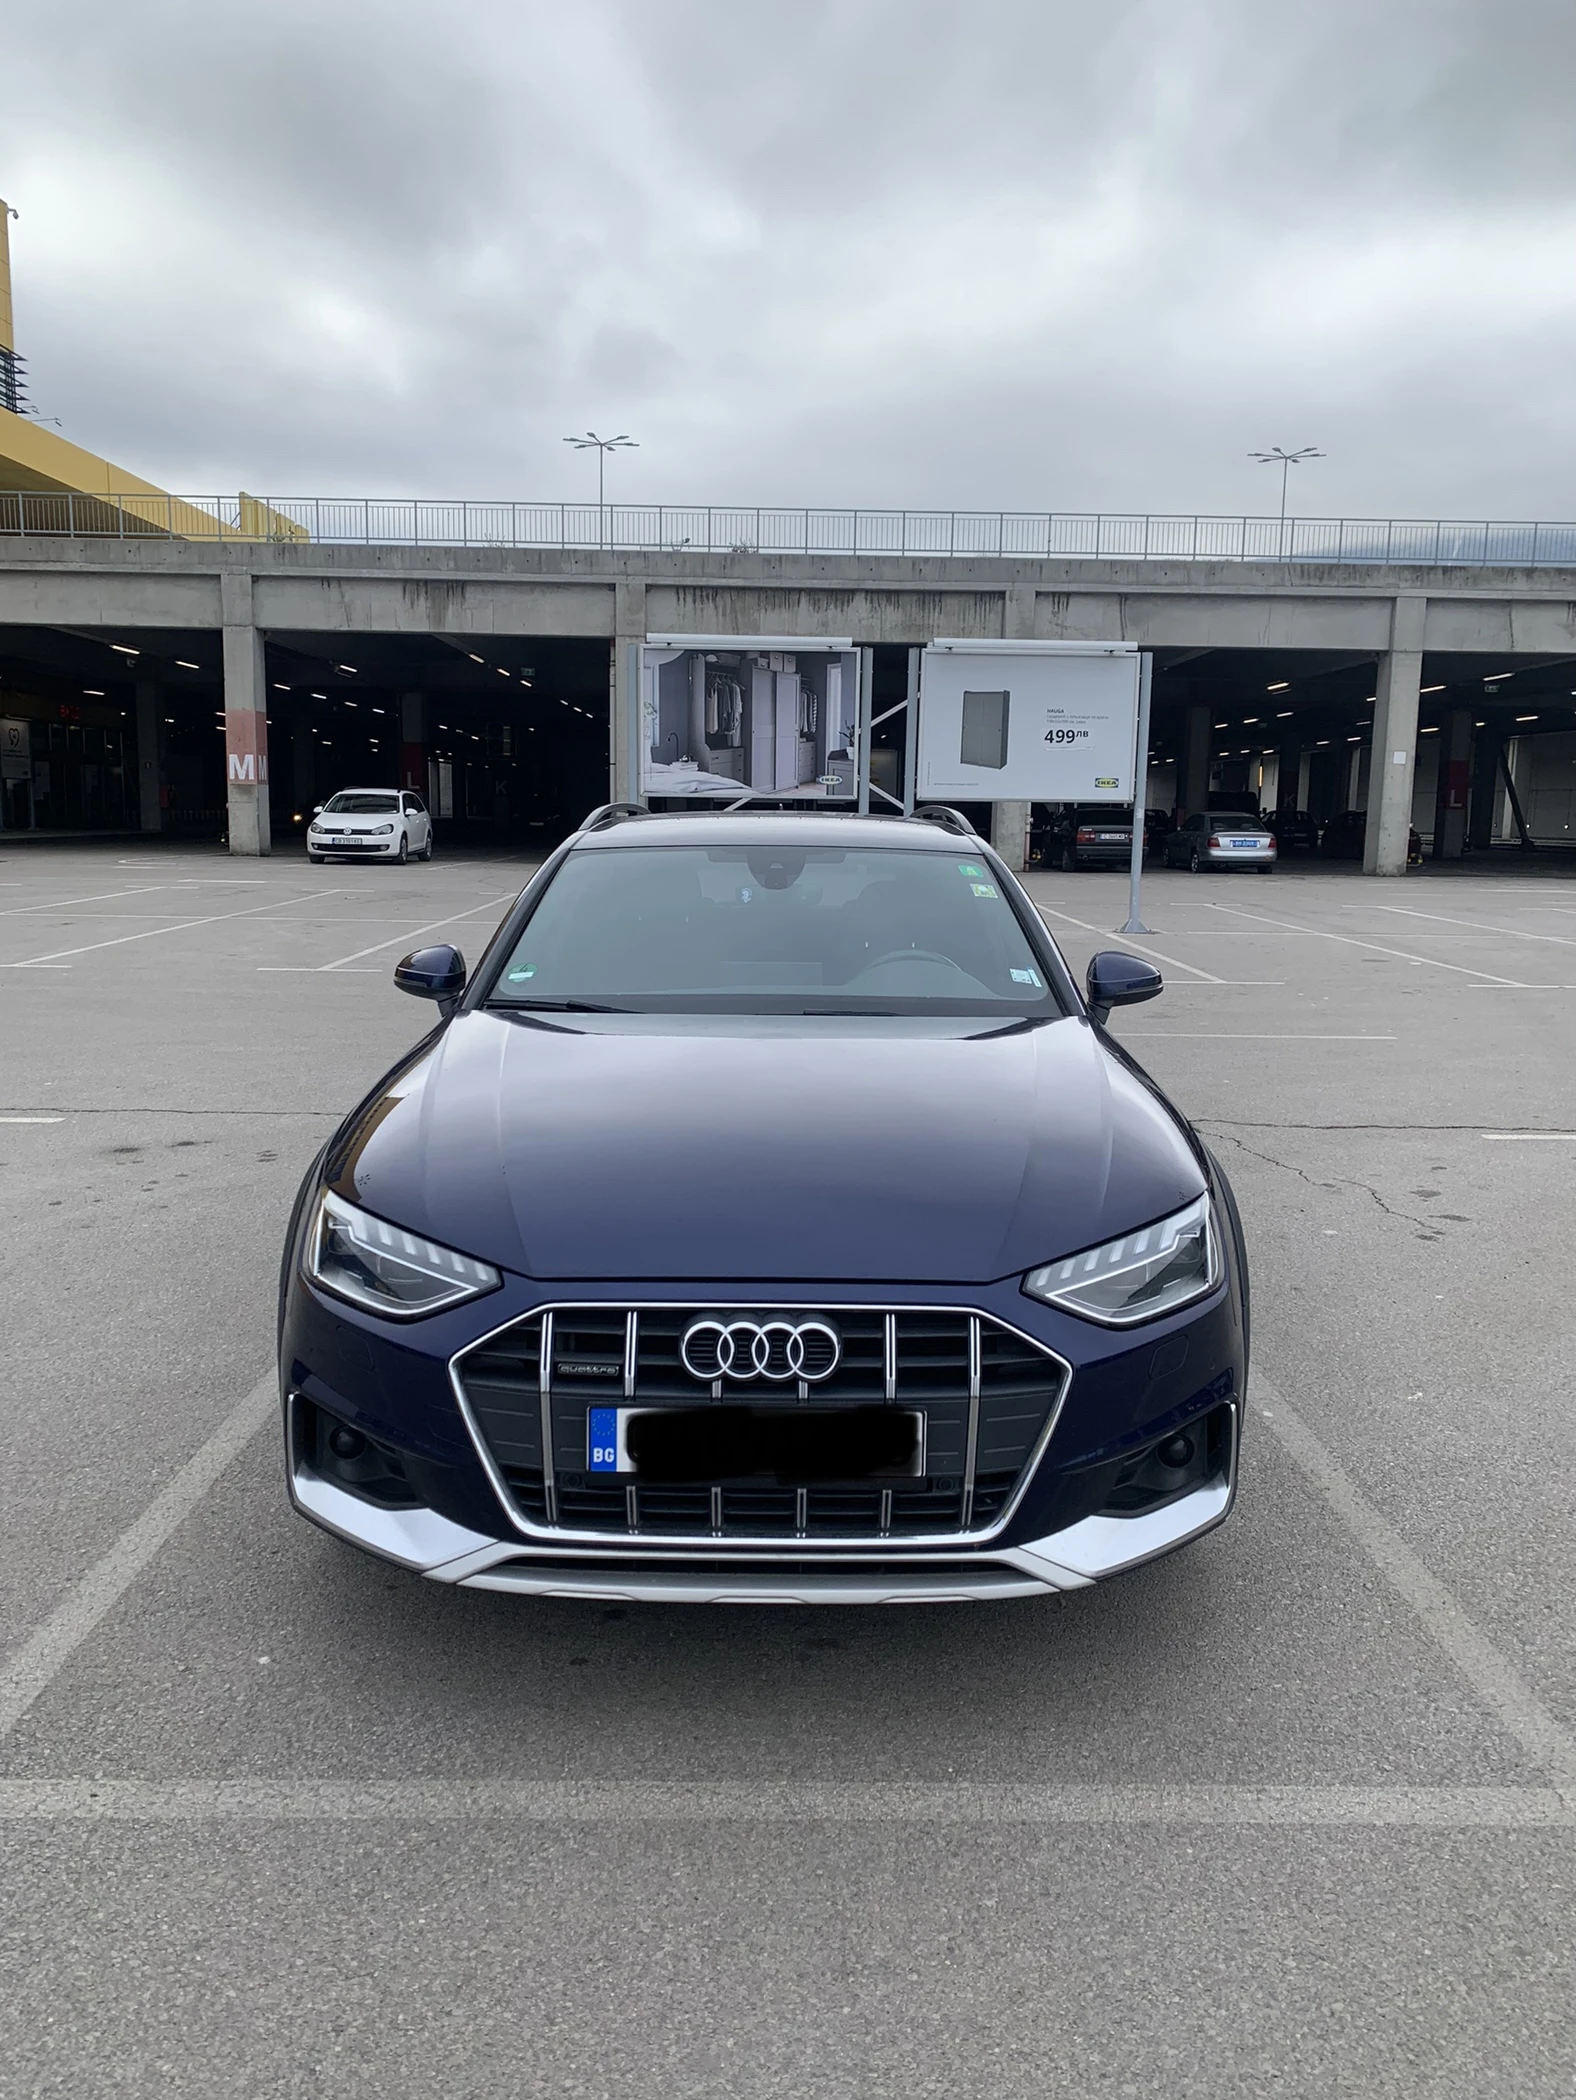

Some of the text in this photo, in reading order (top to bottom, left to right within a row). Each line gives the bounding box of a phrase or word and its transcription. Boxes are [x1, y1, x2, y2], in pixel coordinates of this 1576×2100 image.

[229, 754, 254, 780] M
[258, 754, 267, 781] M
[407, 771, 420, 789] L
[496, 780, 508, 795] K
[1283, 793, 1296, 808] K
[1450, 789, 1462, 807] L
[560, 1365, 616, 1375] quattro
[593, 1447, 615, 1463] BG
